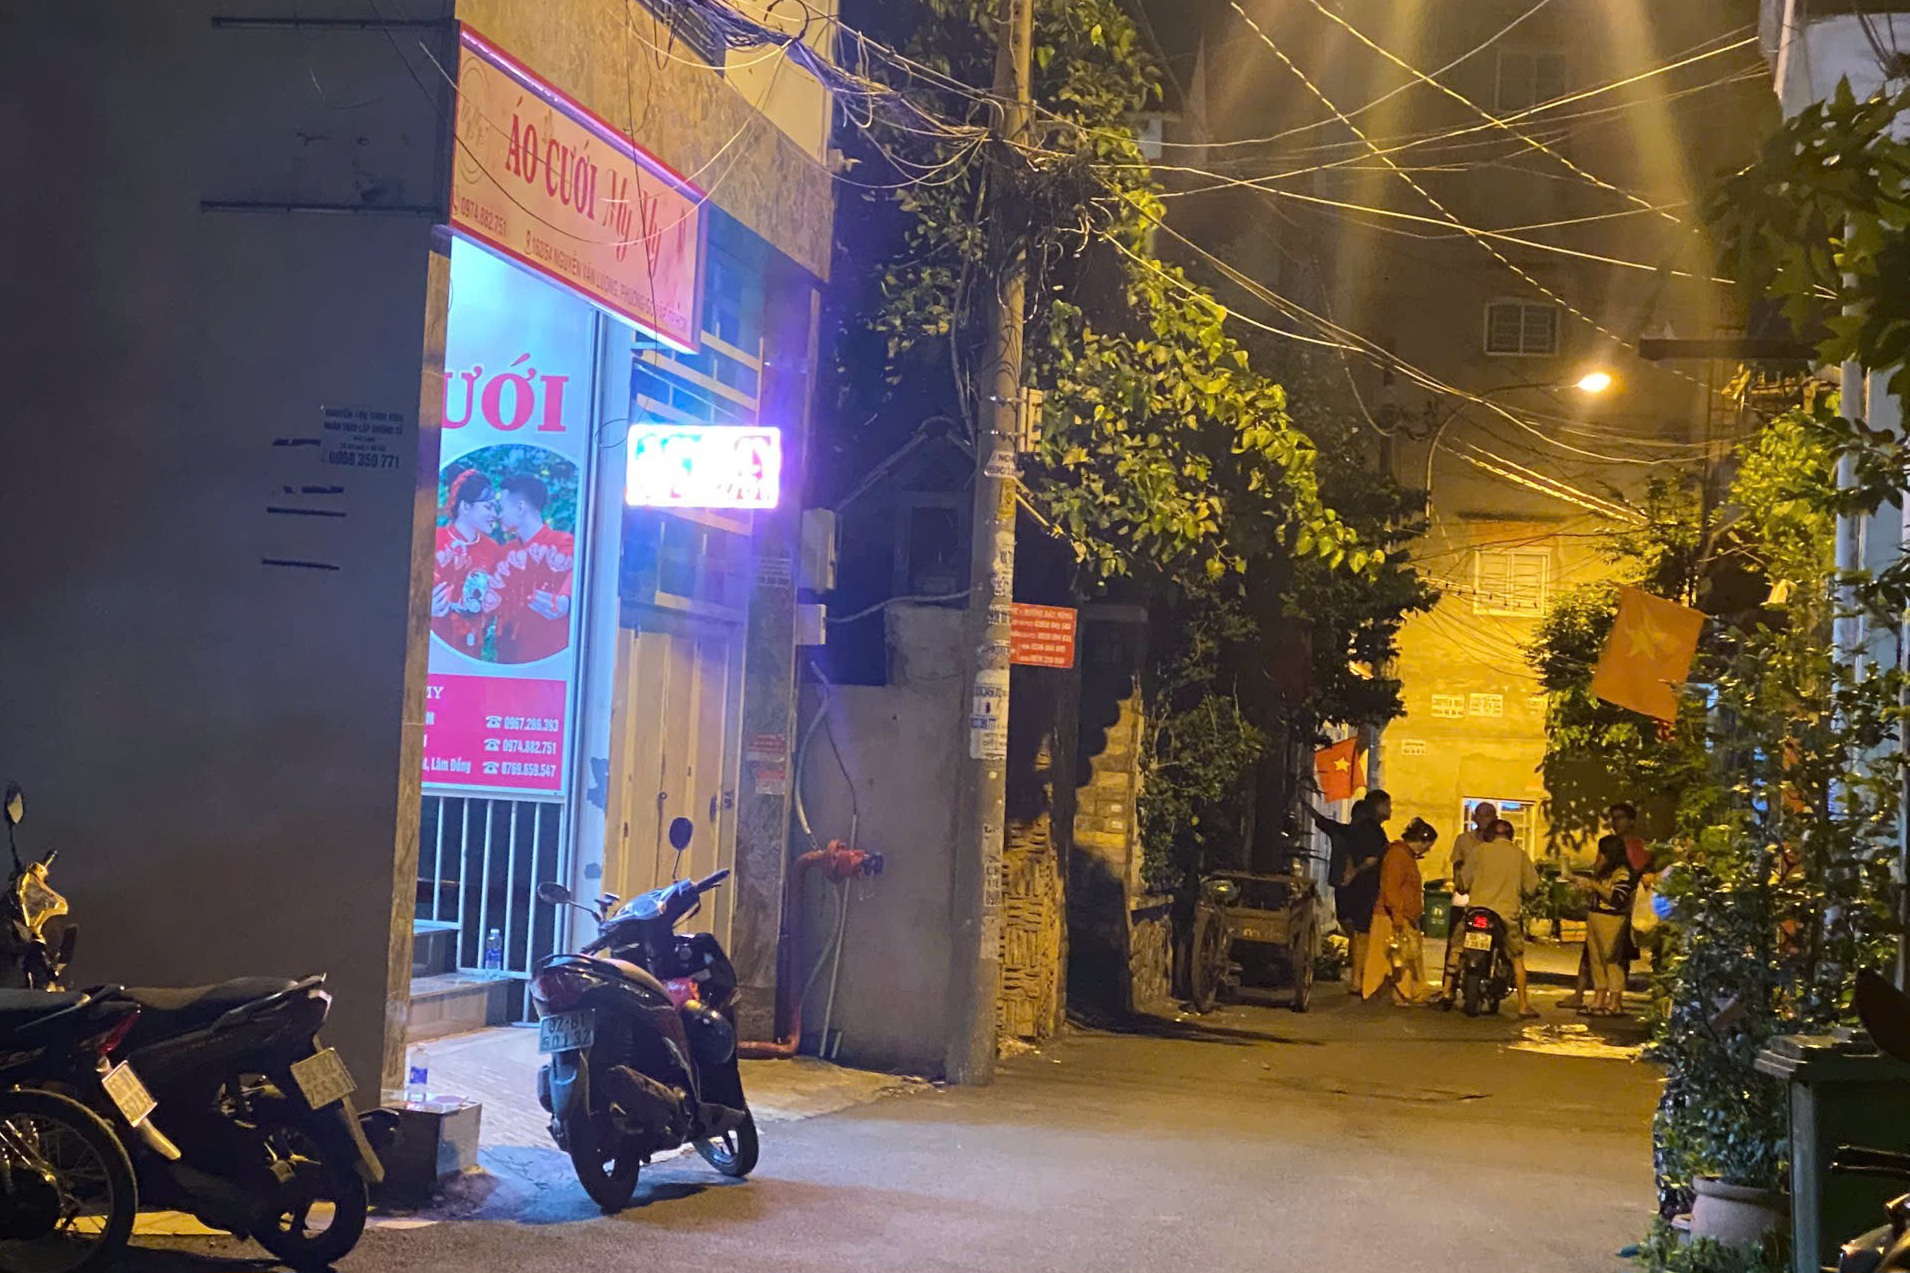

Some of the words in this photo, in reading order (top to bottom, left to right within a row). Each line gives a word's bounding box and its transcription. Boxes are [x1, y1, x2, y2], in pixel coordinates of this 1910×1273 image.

[504, 95, 539, 185] ÁO
[545, 139, 599, 221] CƯỚI
[382, 454, 399, 469] 771
